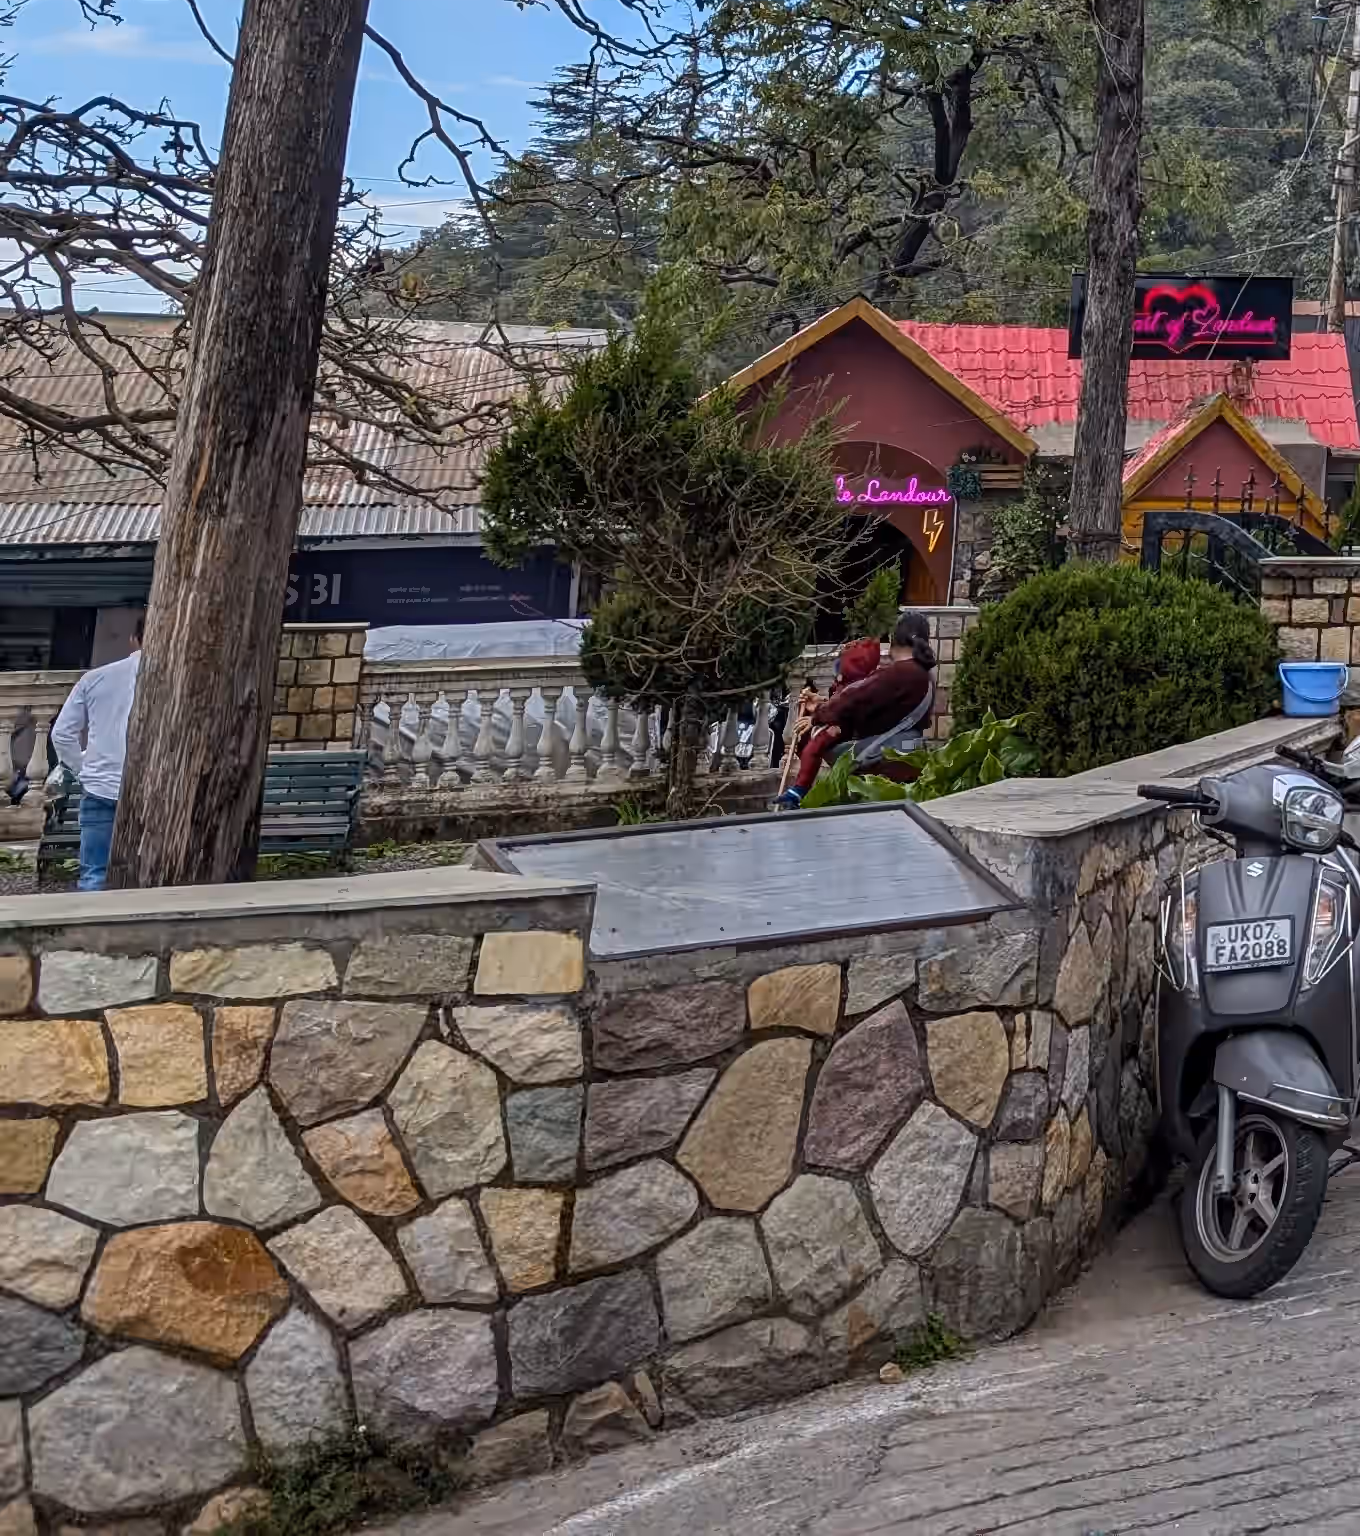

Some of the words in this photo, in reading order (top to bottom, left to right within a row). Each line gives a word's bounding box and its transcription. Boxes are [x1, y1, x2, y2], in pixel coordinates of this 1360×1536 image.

[857, 477, 952, 502] Landour
[1227, 923, 1276, 943] UK07
[1215, 939, 1287, 963] FA2088
